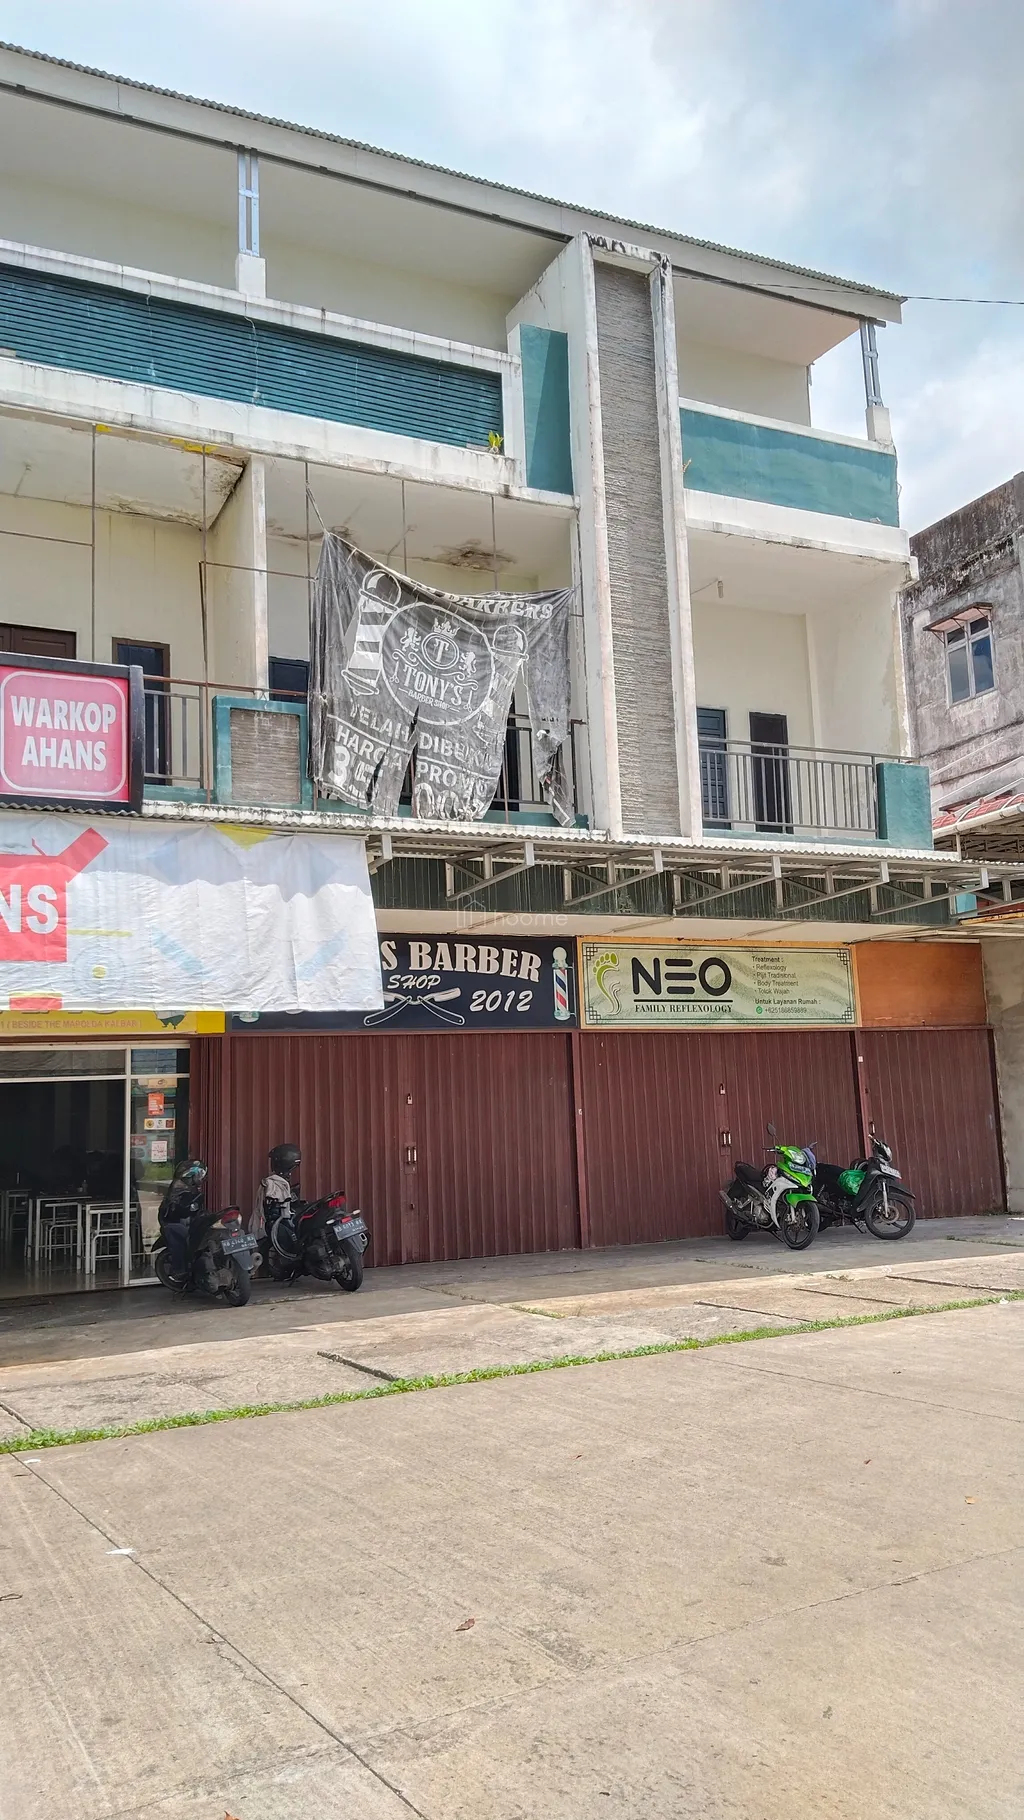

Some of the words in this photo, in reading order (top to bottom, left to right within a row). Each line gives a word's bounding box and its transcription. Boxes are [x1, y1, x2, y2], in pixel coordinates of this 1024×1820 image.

[403, 664, 463, 706] TONY'S
[408, 689, 434, 707] BARBER
[433, 699, 451, 711] SHOP
[10, 695, 117, 733] WARKOP
[21, 735, 107, 771] AHANS
[408, 941, 542, 983] BARBER
[756, 964, 787, 972] Reflexology
[387, 974, 441, 990] SHOP
[631, 957, 732, 996] NEO
[469, 990, 533, 1012] 2012
[635, 1004, 667, 1013] FAMILY
[669, 1004, 733, 1013] REFLEXOLOGY
[773, 998, 797, 1006] Layanan
[44, 1019, 61, 1029] THE
